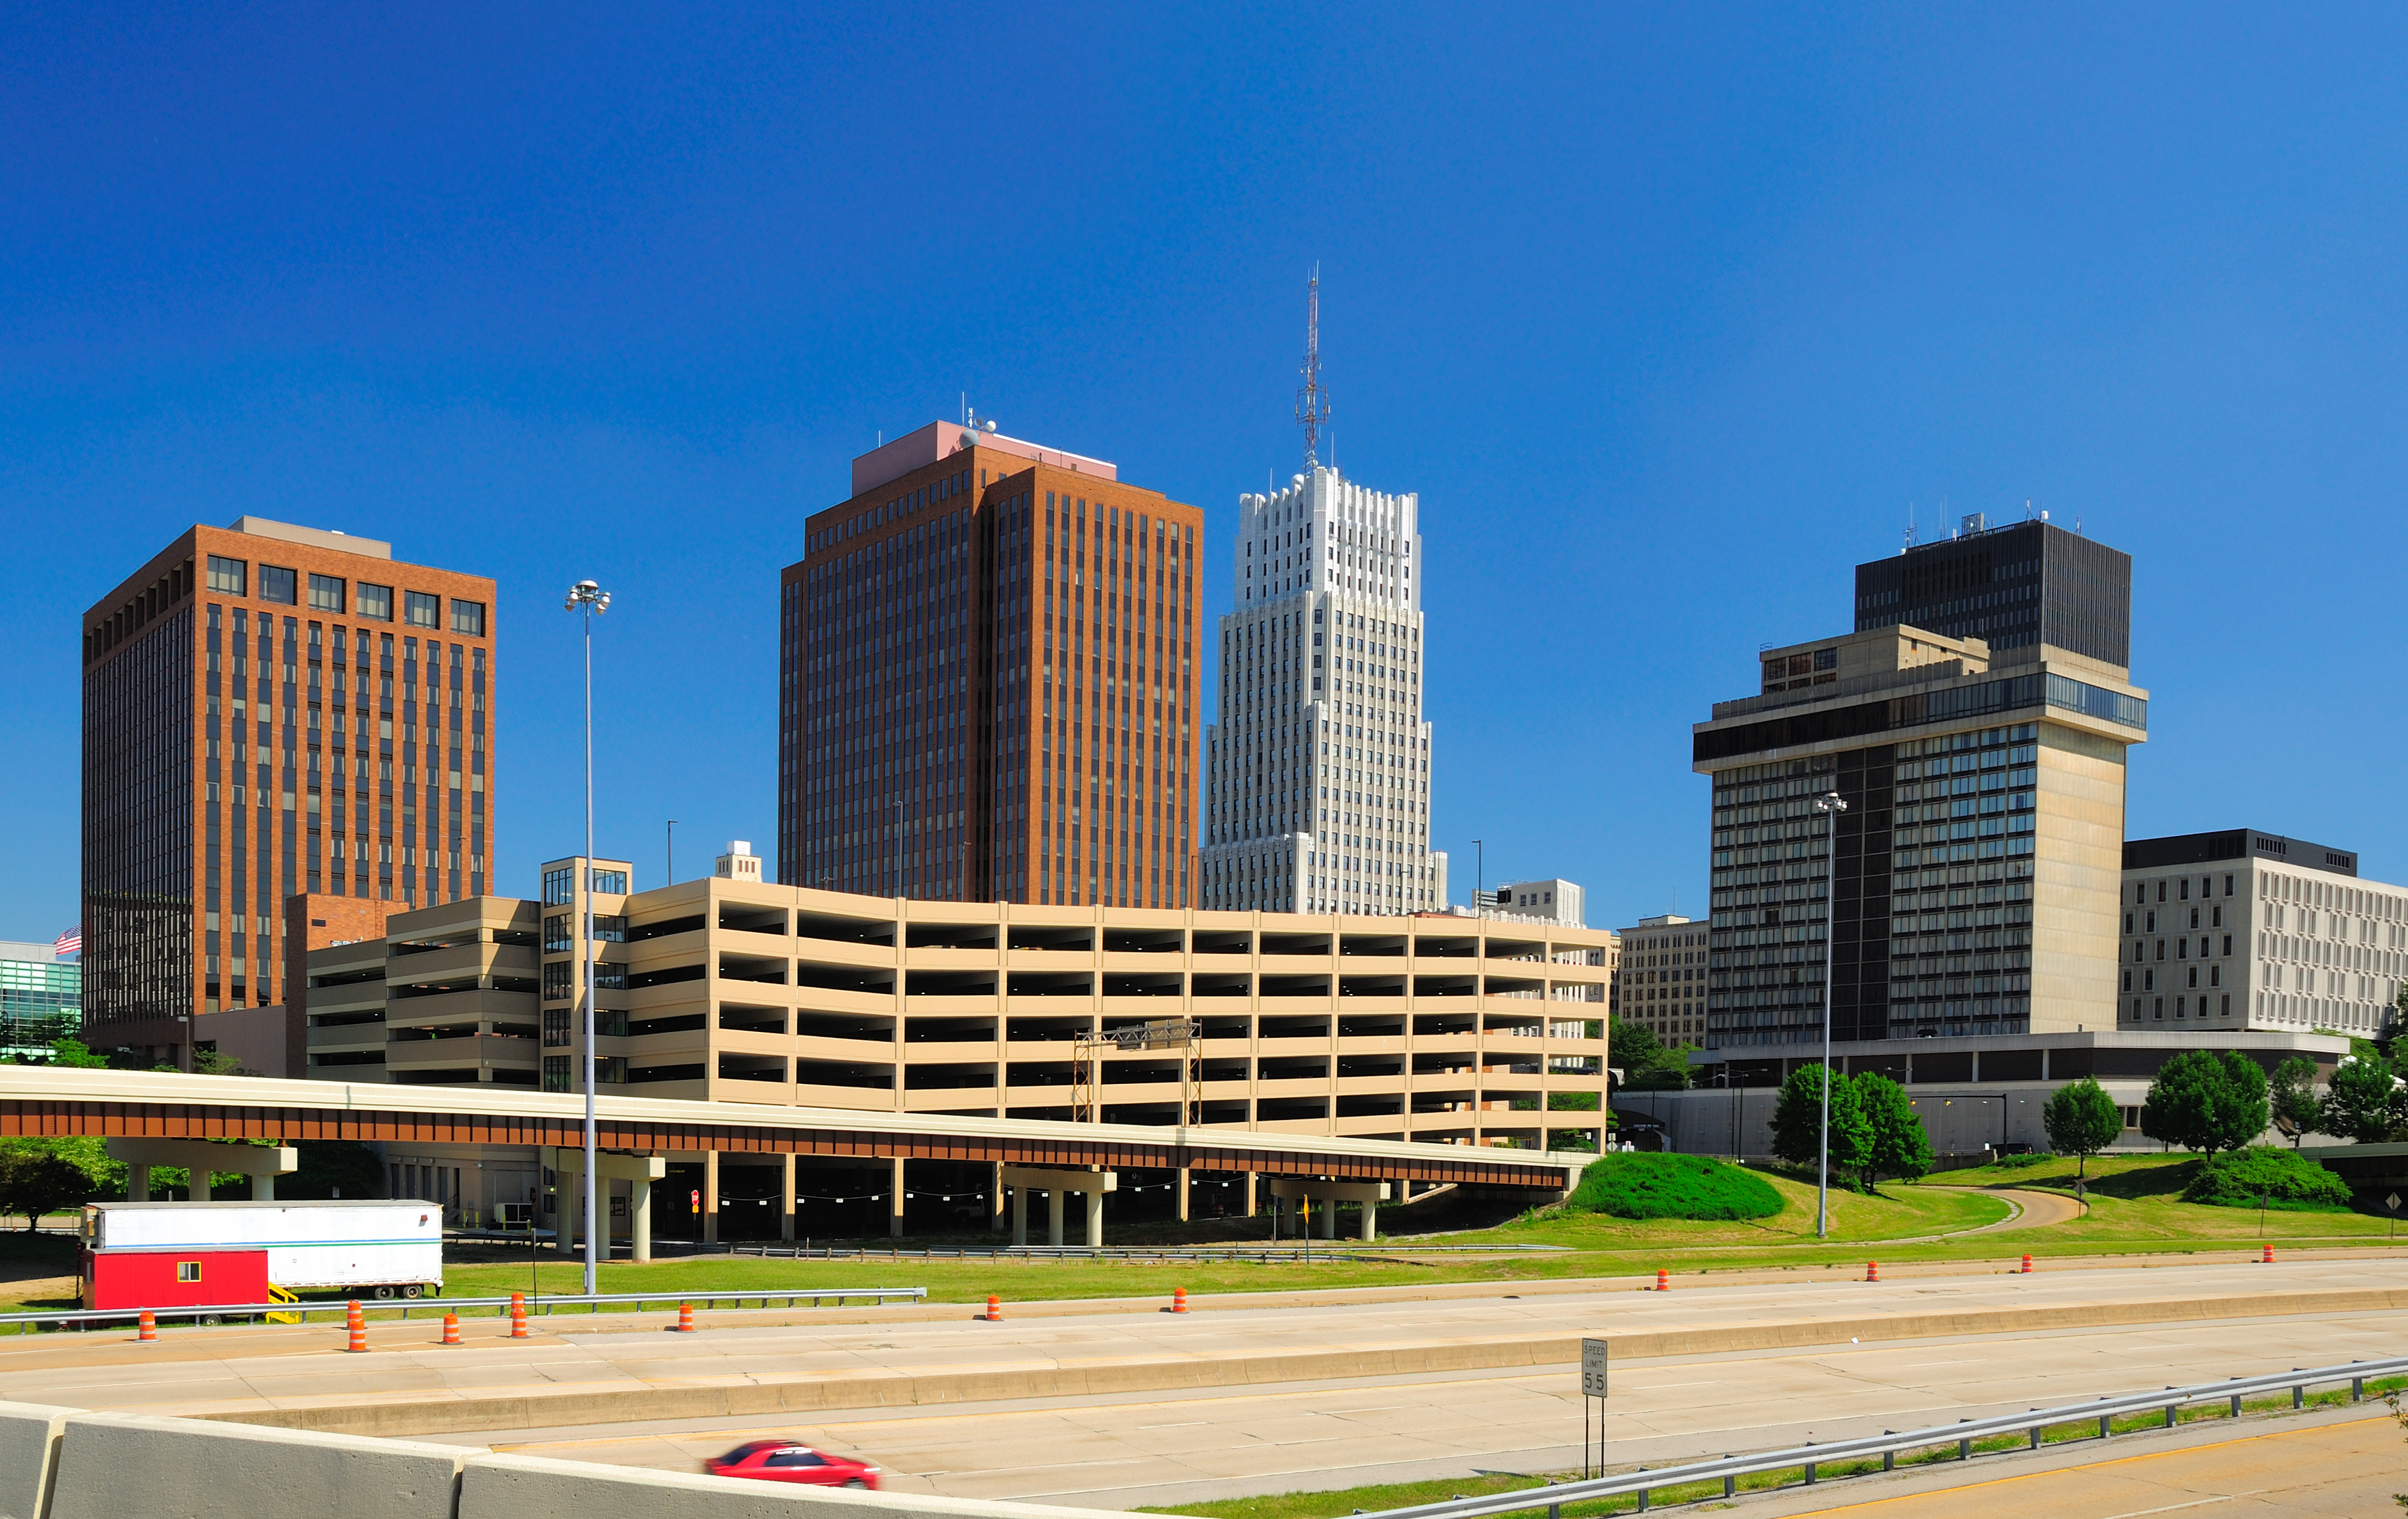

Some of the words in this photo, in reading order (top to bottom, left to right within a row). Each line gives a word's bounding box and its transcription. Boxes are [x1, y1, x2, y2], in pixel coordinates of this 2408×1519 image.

[1584, 1345, 1605, 1355] SPEED
[1586, 1359, 1603, 1369] LIMIT
[1585, 1372, 1604, 1390] 55
